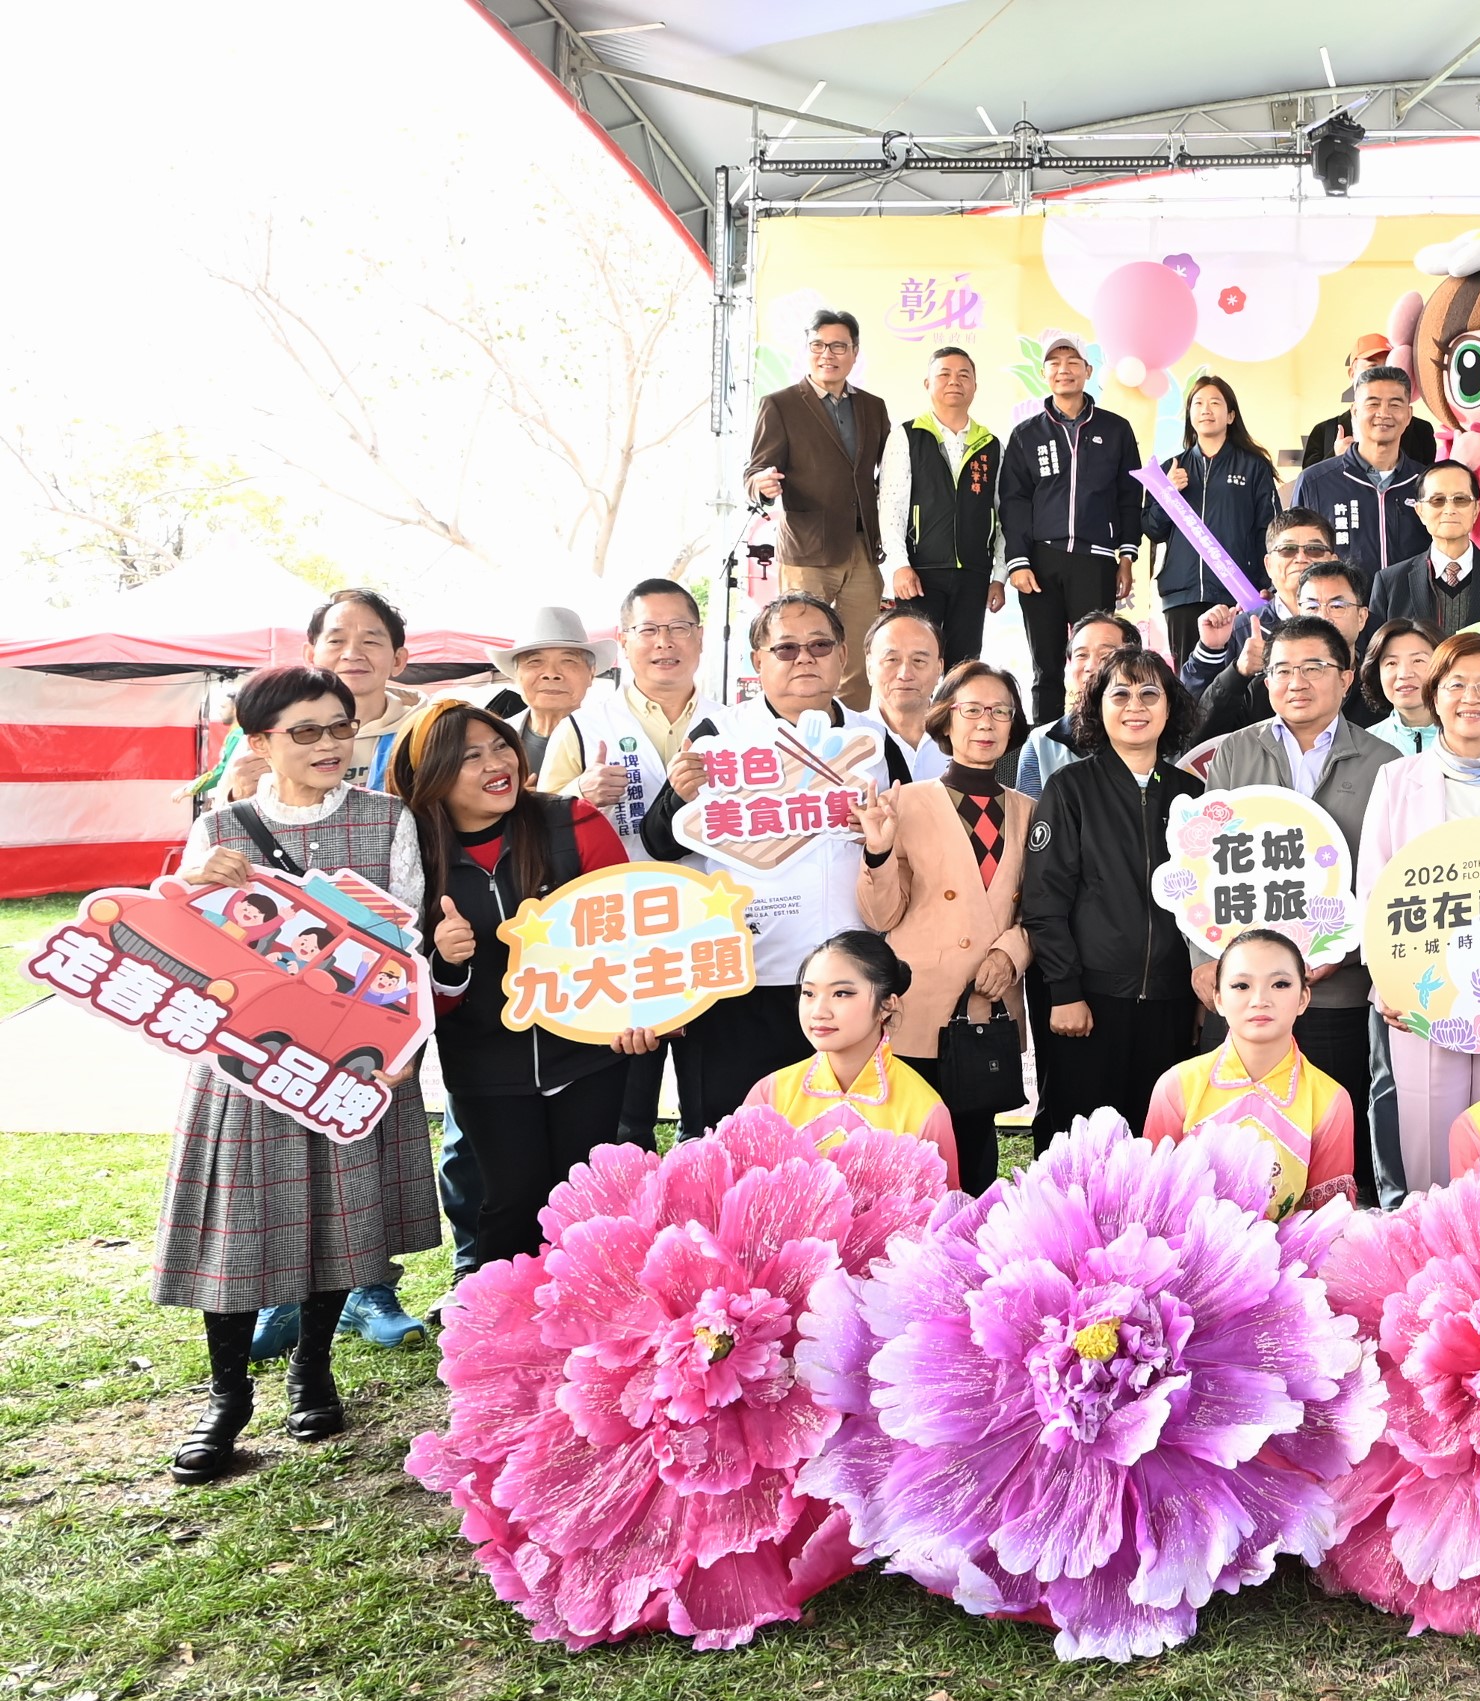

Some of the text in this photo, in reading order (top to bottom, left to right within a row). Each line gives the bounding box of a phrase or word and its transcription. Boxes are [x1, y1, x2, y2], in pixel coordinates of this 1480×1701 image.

[900, 273, 979, 330] 彰化
[703, 747, 780, 789] 特色
[704, 790, 860, 840] 美食市集
[1212, 827, 1306, 875] 花城
[1404, 863, 1459, 887] 2026
[570, 885, 680, 948] 假日
[1214, 879, 1308, 925] 時旅
[513, 935, 745, 1019] 九大主題
[34, 929, 383, 1136] 走春第一品牌
